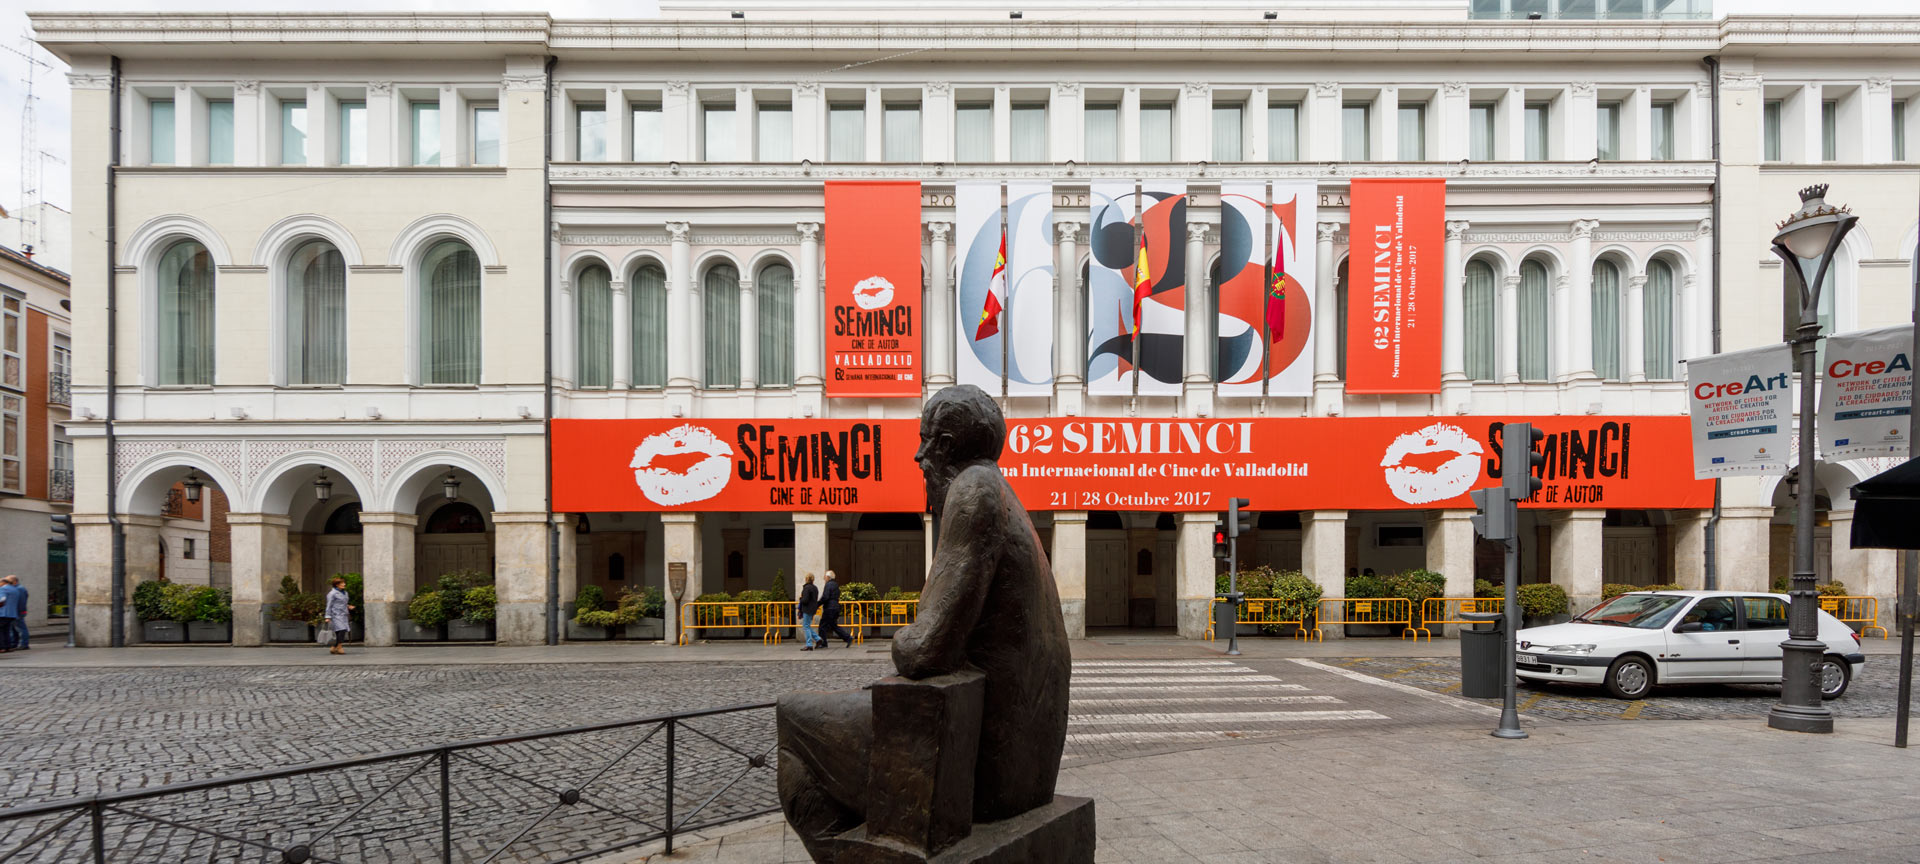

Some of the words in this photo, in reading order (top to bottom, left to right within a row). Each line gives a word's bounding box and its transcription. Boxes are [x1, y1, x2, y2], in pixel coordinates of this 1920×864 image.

[1395, 196, 1403, 241] Valladolid
[1395, 242, 1403, 251] de
[1409, 246, 1417, 265] 2017
[1395, 252, 1403, 274] Cine
[1374, 224, 1392, 323] SEMINCI
[1395, 276, 1402, 285] de
[1408, 266, 1417, 300] Octubre
[1393, 286, 1402, 343] Internacional
[1408, 301, 1416, 311] 28
[835, 305, 912, 337] SEMINCI
[1408, 318, 1415, 328] 21
[852, 339, 865, 350] CINE
[868, 339, 874, 350] DE
[878, 339, 899, 350] AUTOR
[1374, 326, 1389, 350] 62
[835, 354, 912, 366] VALLADOLID
[1392, 344, 1400, 378] Semana
[1829, 353, 1912, 379] CreA
[835, 368, 844, 381] 62
[1837, 379, 1870, 388] NETWORK
[1694, 372, 1788, 401] CreArt
[1845, 384, 1876, 392] ARTISTIC
[1878, 381, 1912, 389] CREATION
[1865, 391, 1900, 399] CIUDADES
[1705, 401, 1732, 409] NETWORK
[1713, 405, 1738, 413] ARTISTIC
[1740, 401, 1769, 409] CREATION
[1731, 411, 1761, 419] CIUDADES
[1008, 424, 1053, 454] 62
[1062, 422, 1255, 454] SEMINCI
[737, 423, 882, 482] SEMINCI
[1486, 421, 1631, 481] SMINCI
[1021, 463, 1135, 477] Internacional
[1138, 463, 1157, 477] de
[1160, 463, 1198, 477] Cine
[1201, 462, 1220, 476] de
[1223, 462, 1309, 477] Valladolid
[770, 487, 794, 506] CINE
[801, 487, 812, 505] DE
[818, 486, 858, 505] AUTOR
[1050, 492, 1067, 506] 21
[1082, 491, 1101, 506] 28
[1105, 490, 1170, 506] Octubre
[1174, 491, 1212, 507] 2017
[1546, 485, 1558, 504] DE
[1563, 485, 1603, 503] AUTOR
